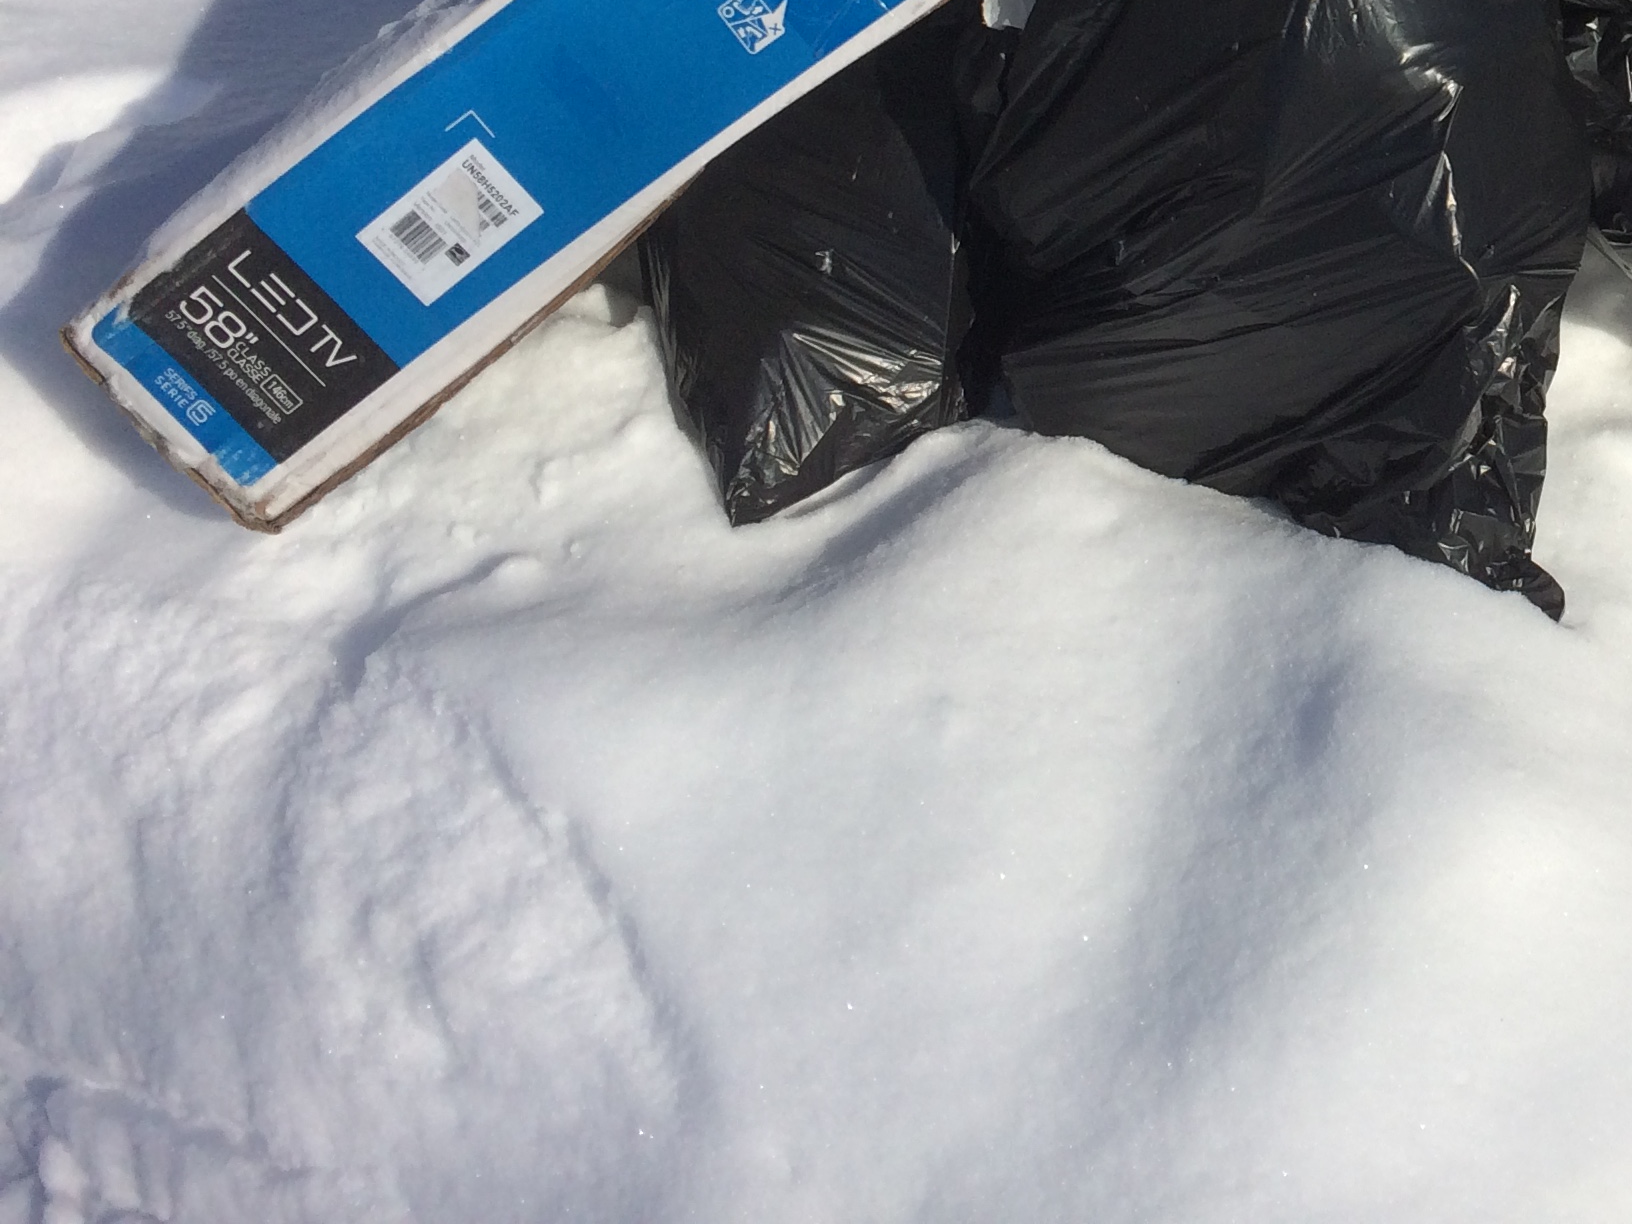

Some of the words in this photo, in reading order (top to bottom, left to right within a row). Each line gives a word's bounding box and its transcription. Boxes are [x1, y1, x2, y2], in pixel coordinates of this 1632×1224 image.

[462, 159, 520, 216] UN58H5202AF
[227, 249, 319, 336] LED
[310, 324, 357, 368] TV
[227, 348, 265, 384] CLASSE
[235, 341, 271, 376] CLASS
[223, 367, 238, 381] po
[235, 378, 247, 391] en
[245, 386, 283, 424] diagonale
[266, 380, 295, 409] 146cm
